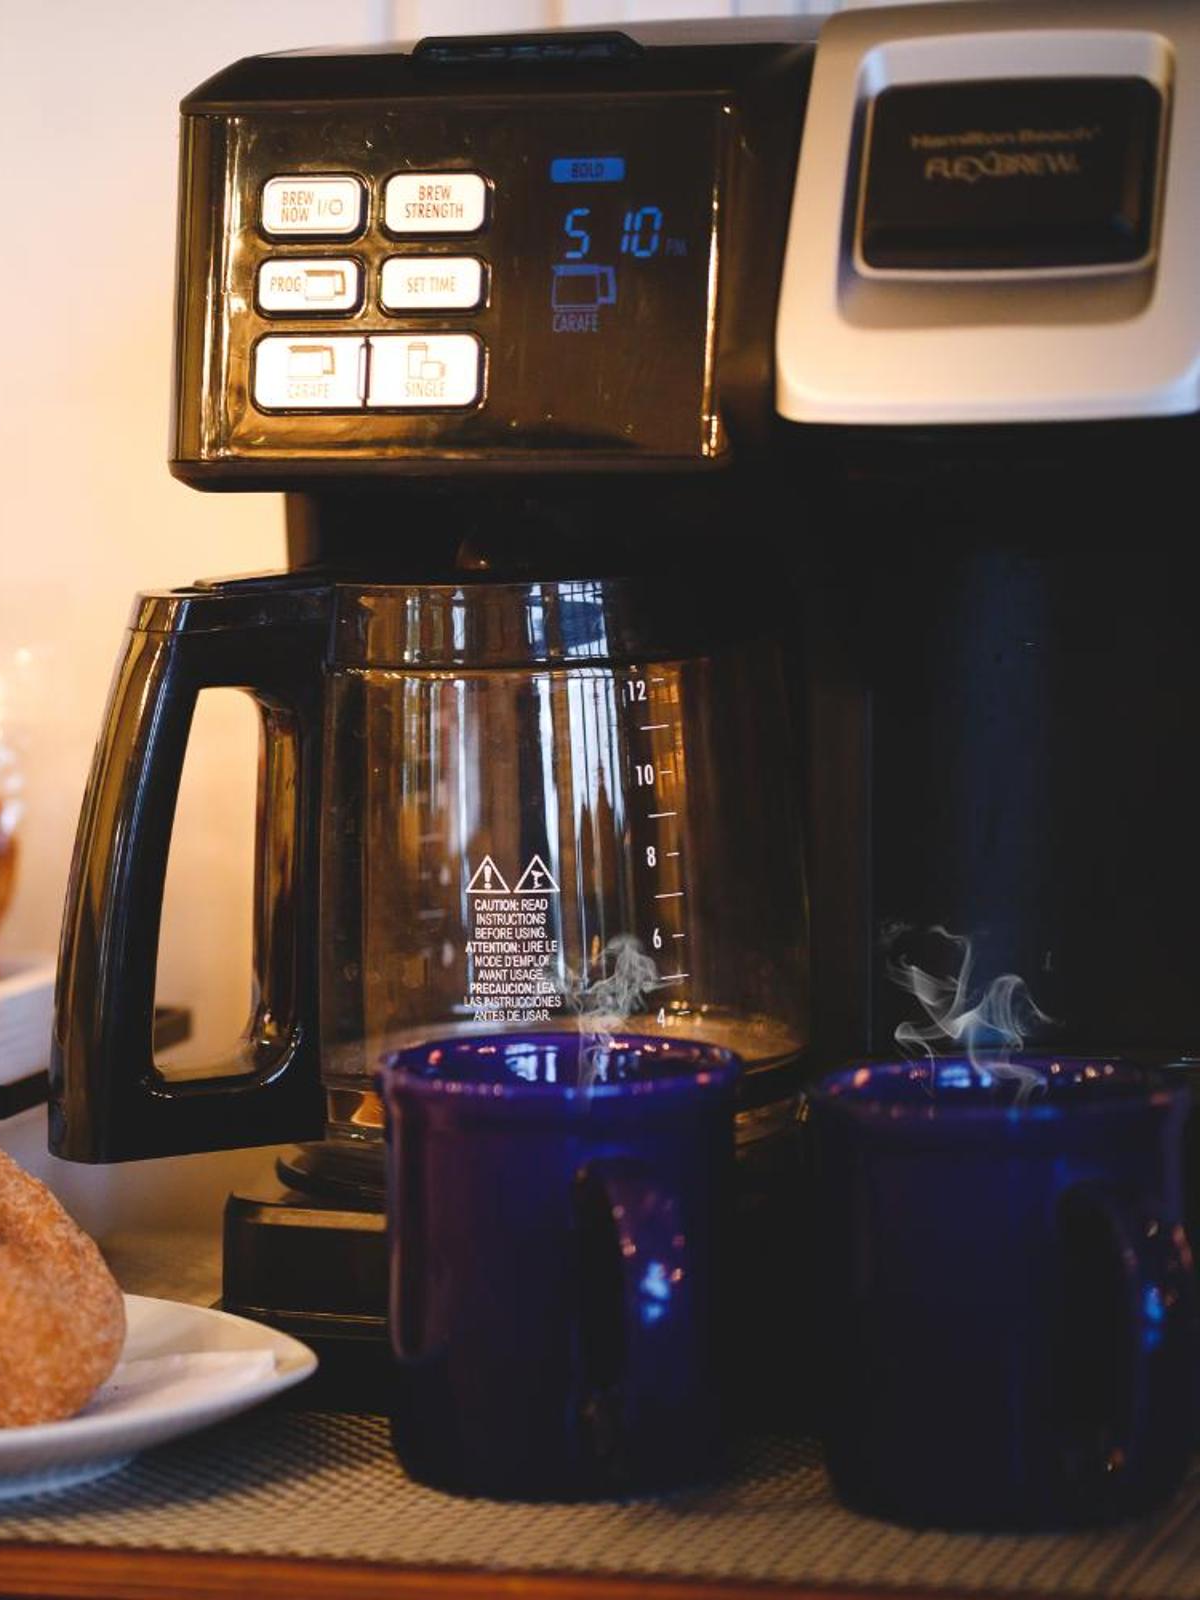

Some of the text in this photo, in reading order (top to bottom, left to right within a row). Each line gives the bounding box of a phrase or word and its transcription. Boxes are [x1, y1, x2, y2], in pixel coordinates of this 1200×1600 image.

[571, 163, 605, 178] BOLD
[281, 191, 314, 206] BREW
[419, 185, 453, 200] BREW
[281, 207, 310, 222] NOW
[405, 203, 464, 219] STRENGTH
[620, 206, 663, 258] 10
[270, 276, 301, 292] PROG
[407, 276, 456, 292] SET TIME
[553, 313, 599, 333] CARAFE
[405, 381, 446, 398] SINGLE
[627, 680, 647, 702] 12
[635, 764, 655, 786] 10
[646, 846, 657, 868] 8
[474, 899, 548, 911] CAUTION: READ
[476, 913, 546, 925] INSTRUCTIONS
[474, 927, 548, 939] BEFORE USING.
[653, 928, 662, 949] 6
[465, 941, 558, 953] ATTENTION: LIRE LE
[474, 955, 503, 967] MODE
[478, 969, 508, 981] AVANT
[469, 982, 556, 994] PRECAUCION: LEA
[463, 995, 562, 1008] LAS INSTRUCCIONES
[473, 1010, 505, 1022] ANTES
[507, 1010, 520, 1021] DE
[657, 1008, 666, 1028] 4
